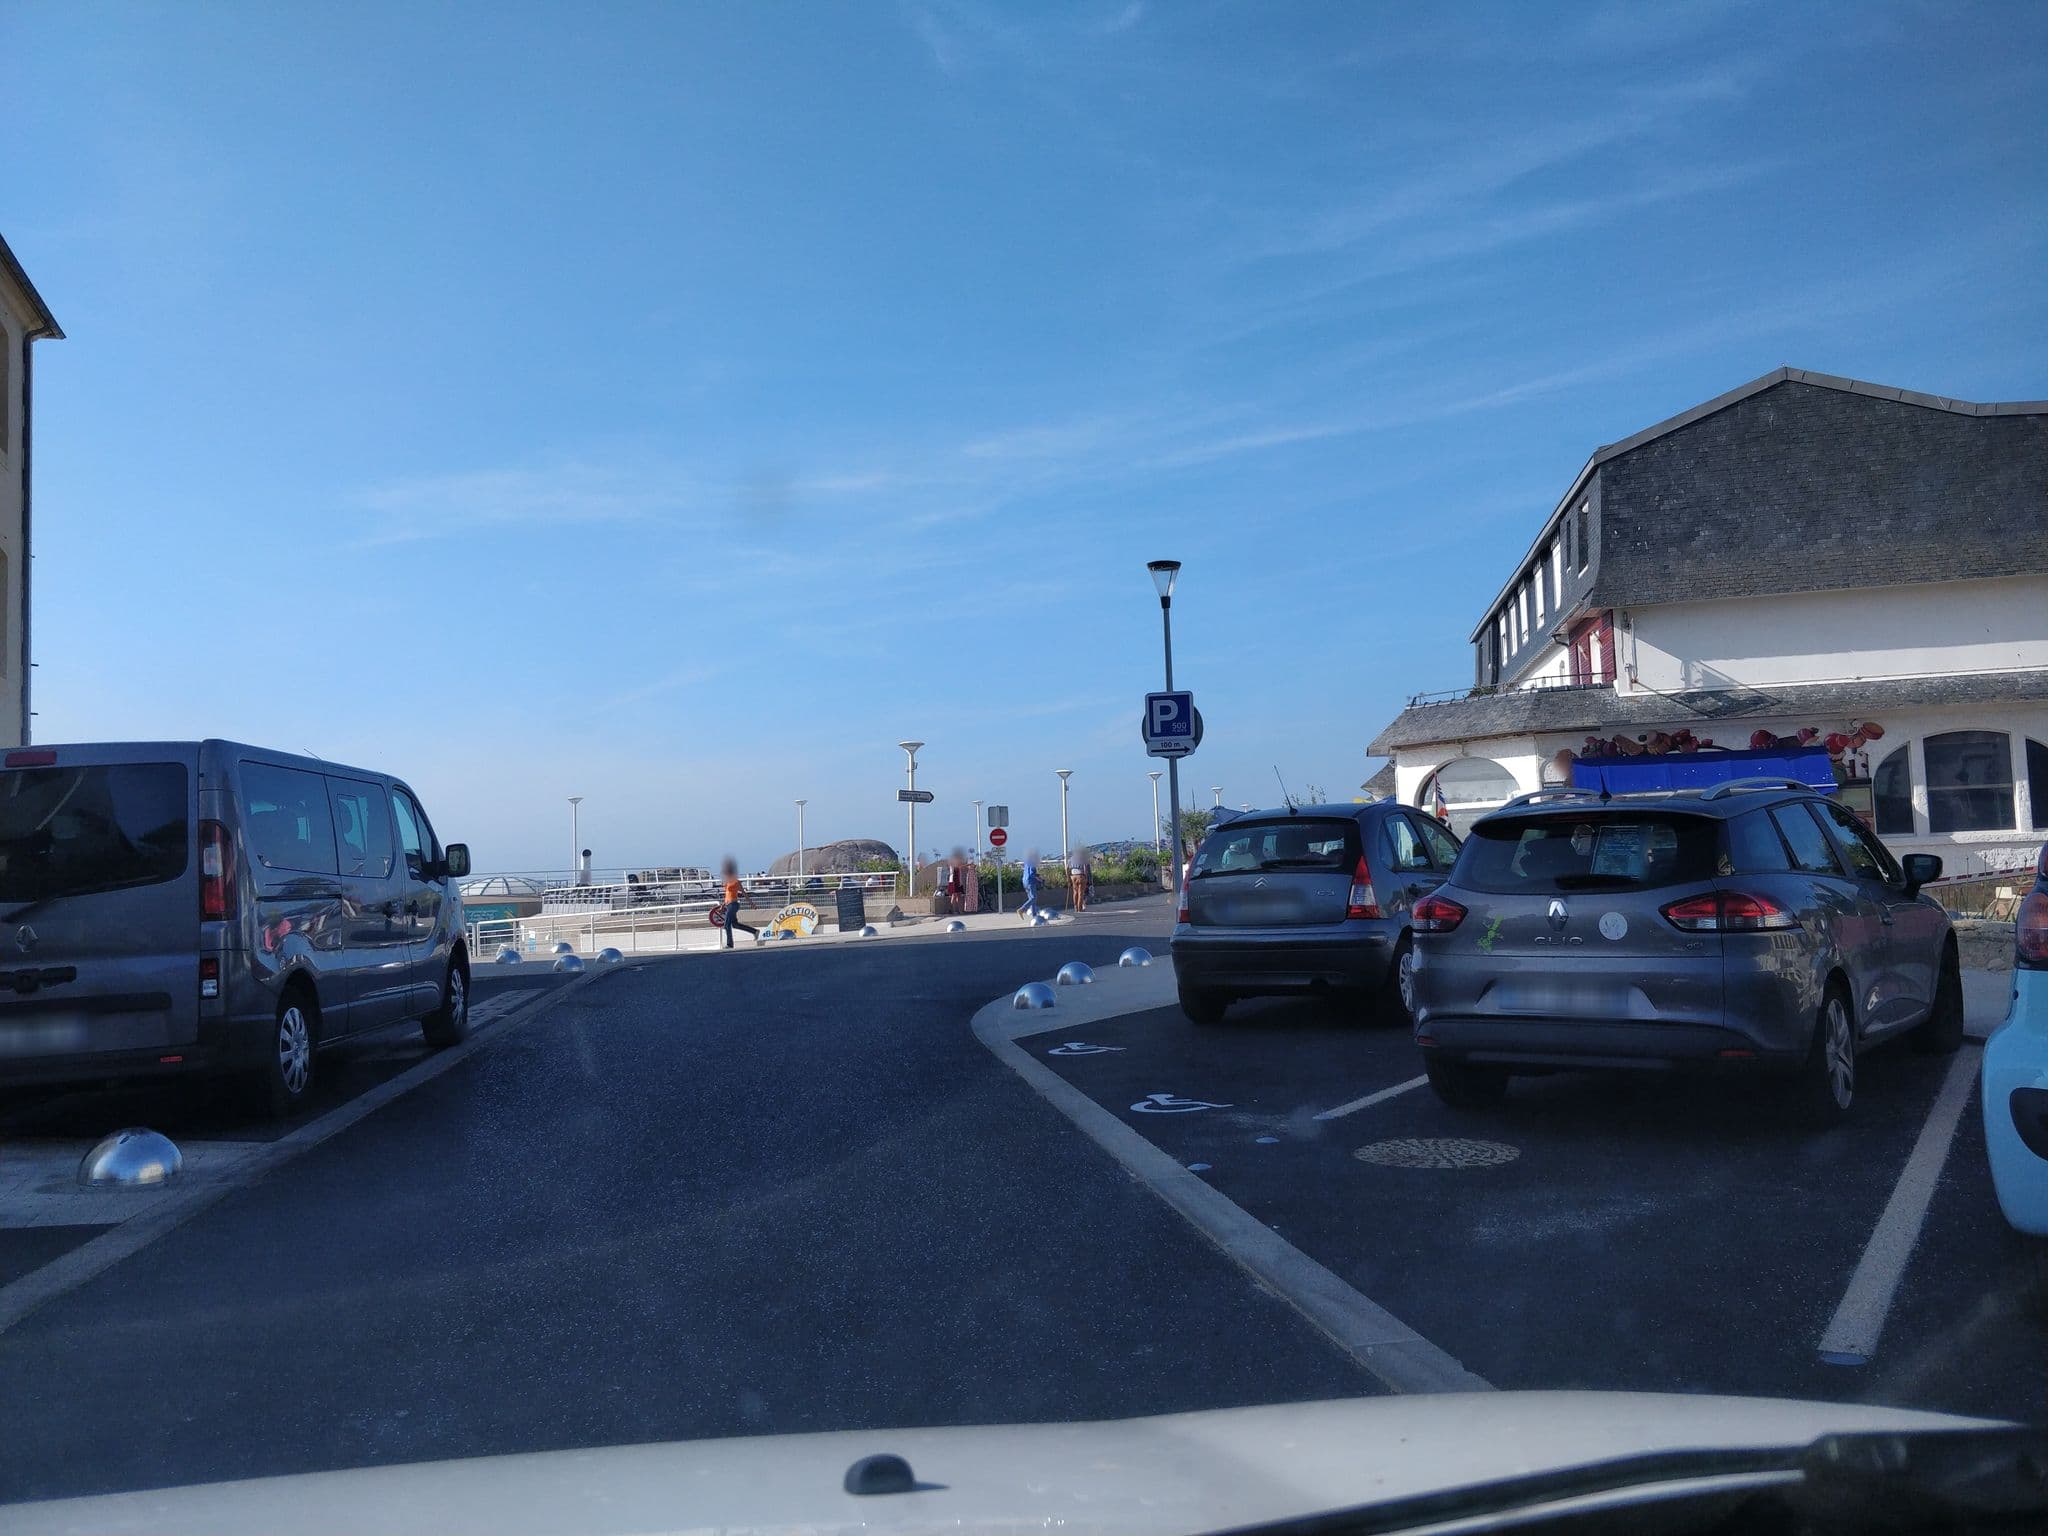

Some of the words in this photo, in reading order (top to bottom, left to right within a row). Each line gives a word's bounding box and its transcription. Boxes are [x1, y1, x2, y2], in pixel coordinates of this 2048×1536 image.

[1153, 700, 1178, 733] P
[775, 907, 816, 924] LOCATION
[1534, 936, 1583, 945] CLIO
